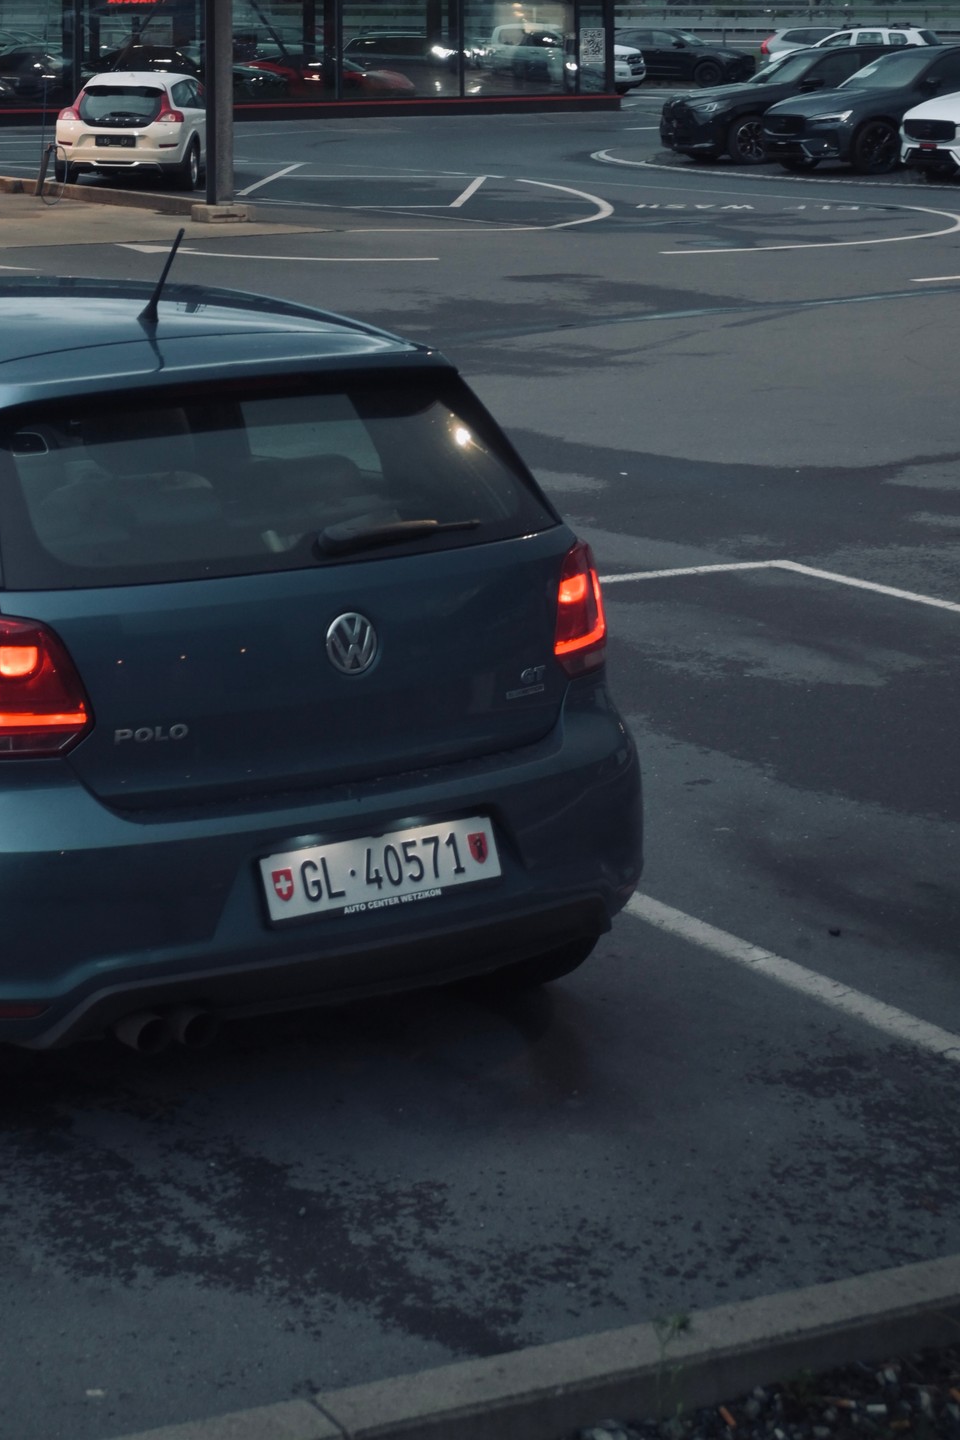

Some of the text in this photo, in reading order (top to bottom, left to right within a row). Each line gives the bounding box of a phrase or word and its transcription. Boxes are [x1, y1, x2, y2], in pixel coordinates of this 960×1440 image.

[114, 723, 189, 745] POLO
[301, 833, 465, 901] GL 40571
[344, 889, 442, 914] AUTO CENTER WETZIKON
